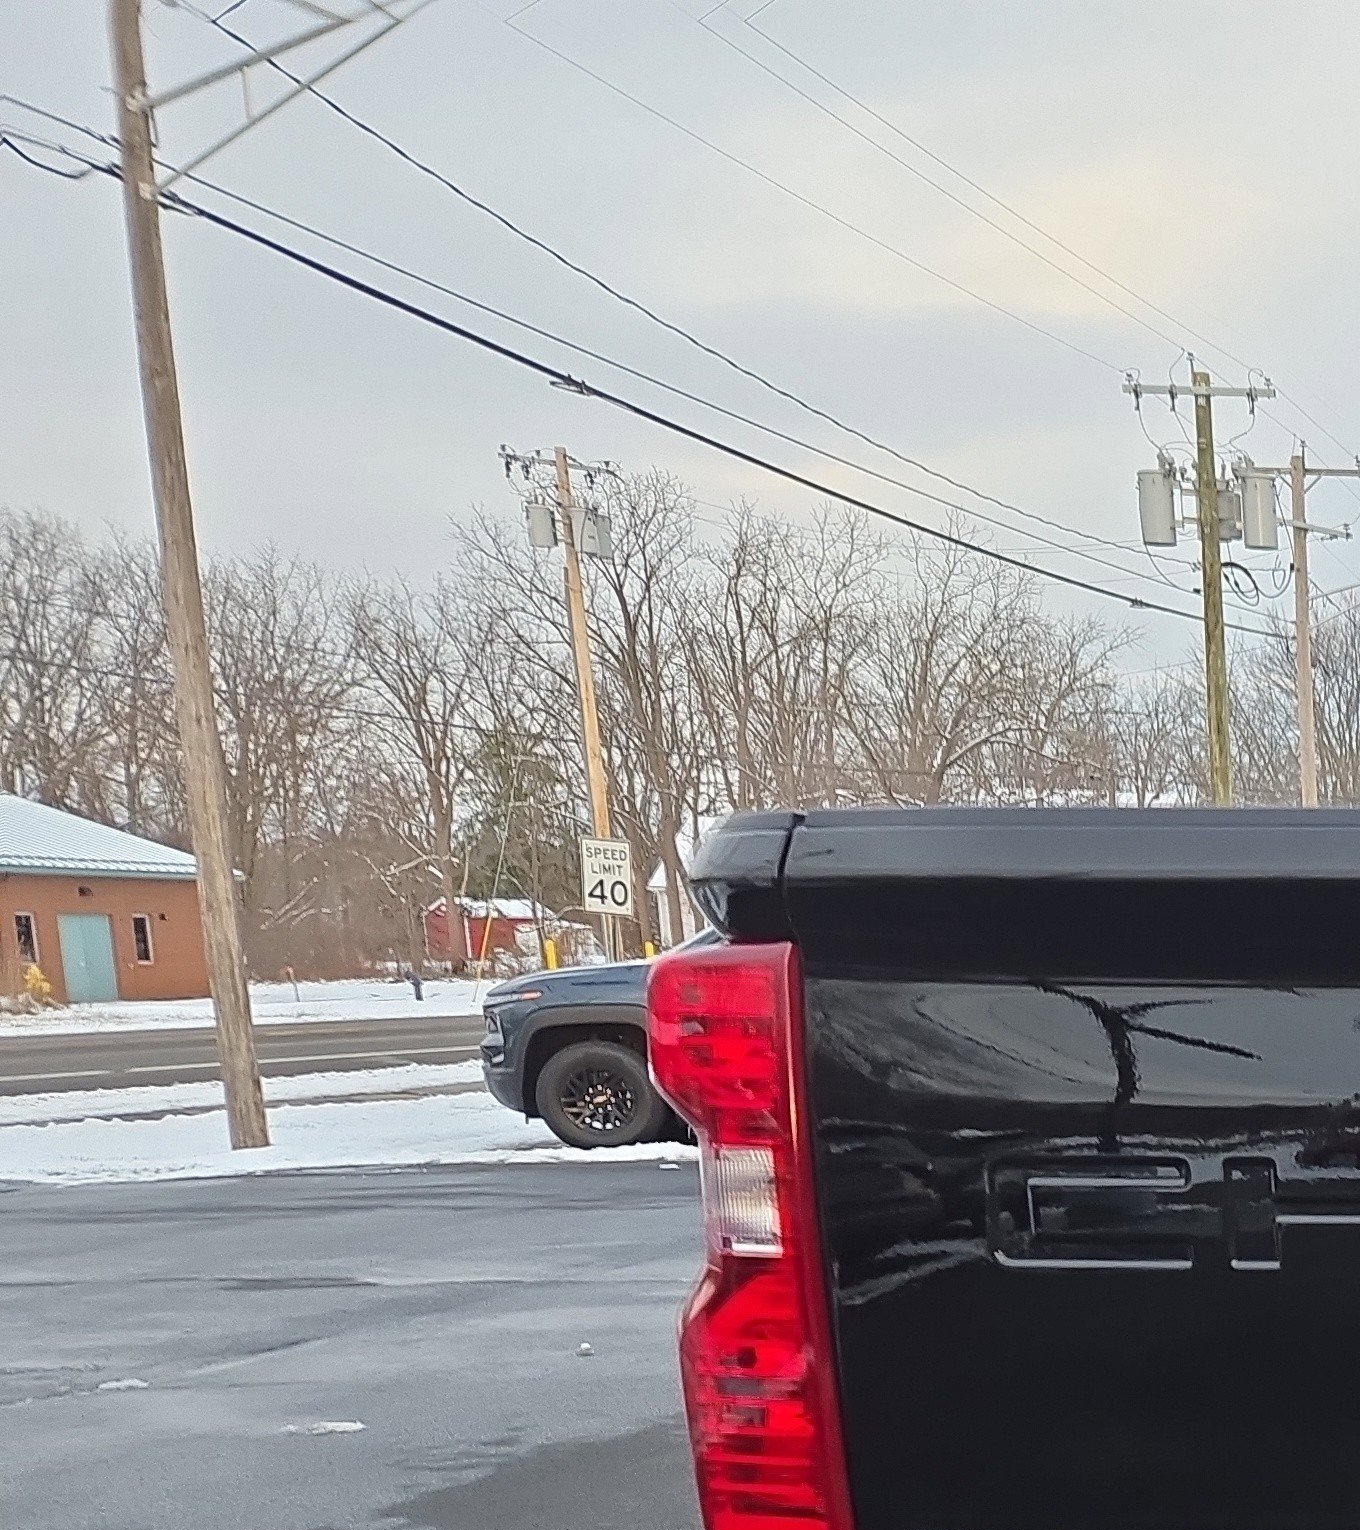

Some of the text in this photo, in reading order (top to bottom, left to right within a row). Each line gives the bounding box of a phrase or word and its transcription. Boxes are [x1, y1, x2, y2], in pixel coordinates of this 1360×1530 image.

[586, 846, 627, 861] SPEED
[591, 862, 624, 876] LIMIT
[588, 878, 628, 907] 40
